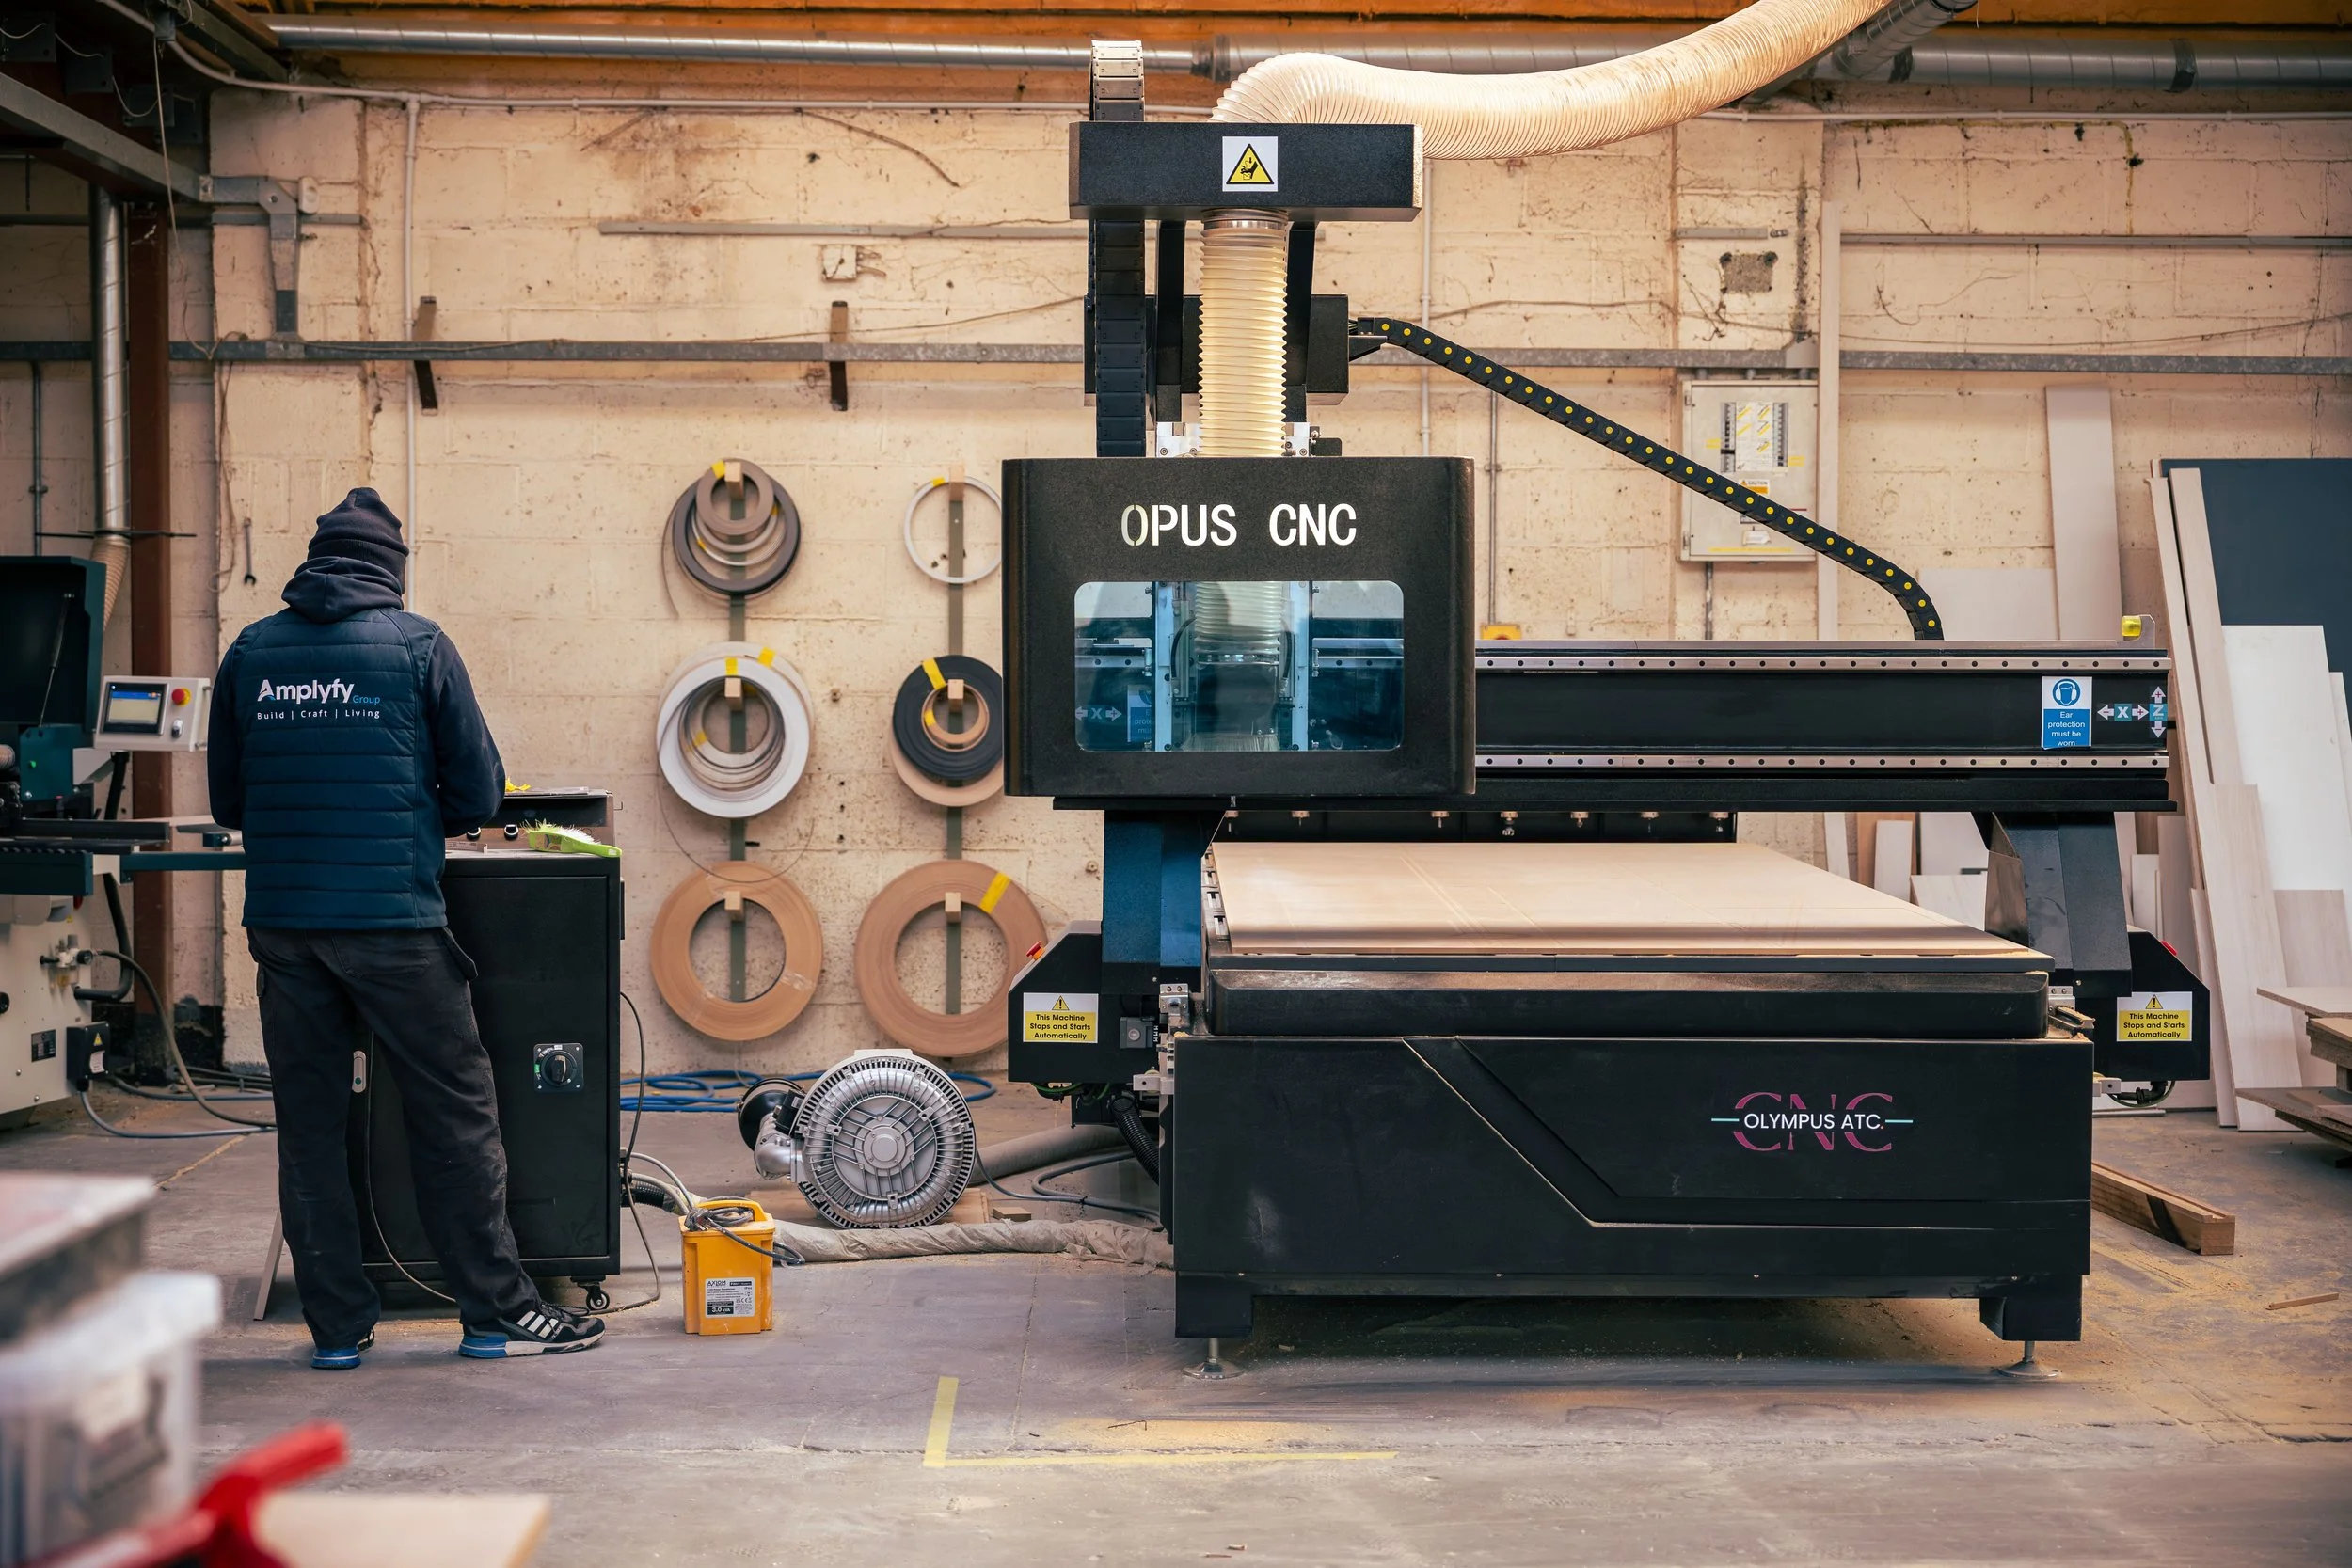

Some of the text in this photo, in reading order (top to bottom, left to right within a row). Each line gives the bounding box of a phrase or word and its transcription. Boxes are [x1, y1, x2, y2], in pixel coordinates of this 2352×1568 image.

[1121, 503, 1357, 546] OPUS CNC
[257, 678, 381, 705] Amplyfy Group
[345, 709, 380, 720] Living
[1091, 707, 1103, 720] X
[2117, 706, 2129, 719] X
[2153, 705, 2165, 717] Z
[2047, 721, 2086, 729] protection
[1034, 1032, 1087, 1040] Automatically
[2127, 1031, 2181, 1039] Automatically
[1733, 1091, 1894, 1152] CNC
[1743, 1113, 1836, 1130] OLYMPUS
